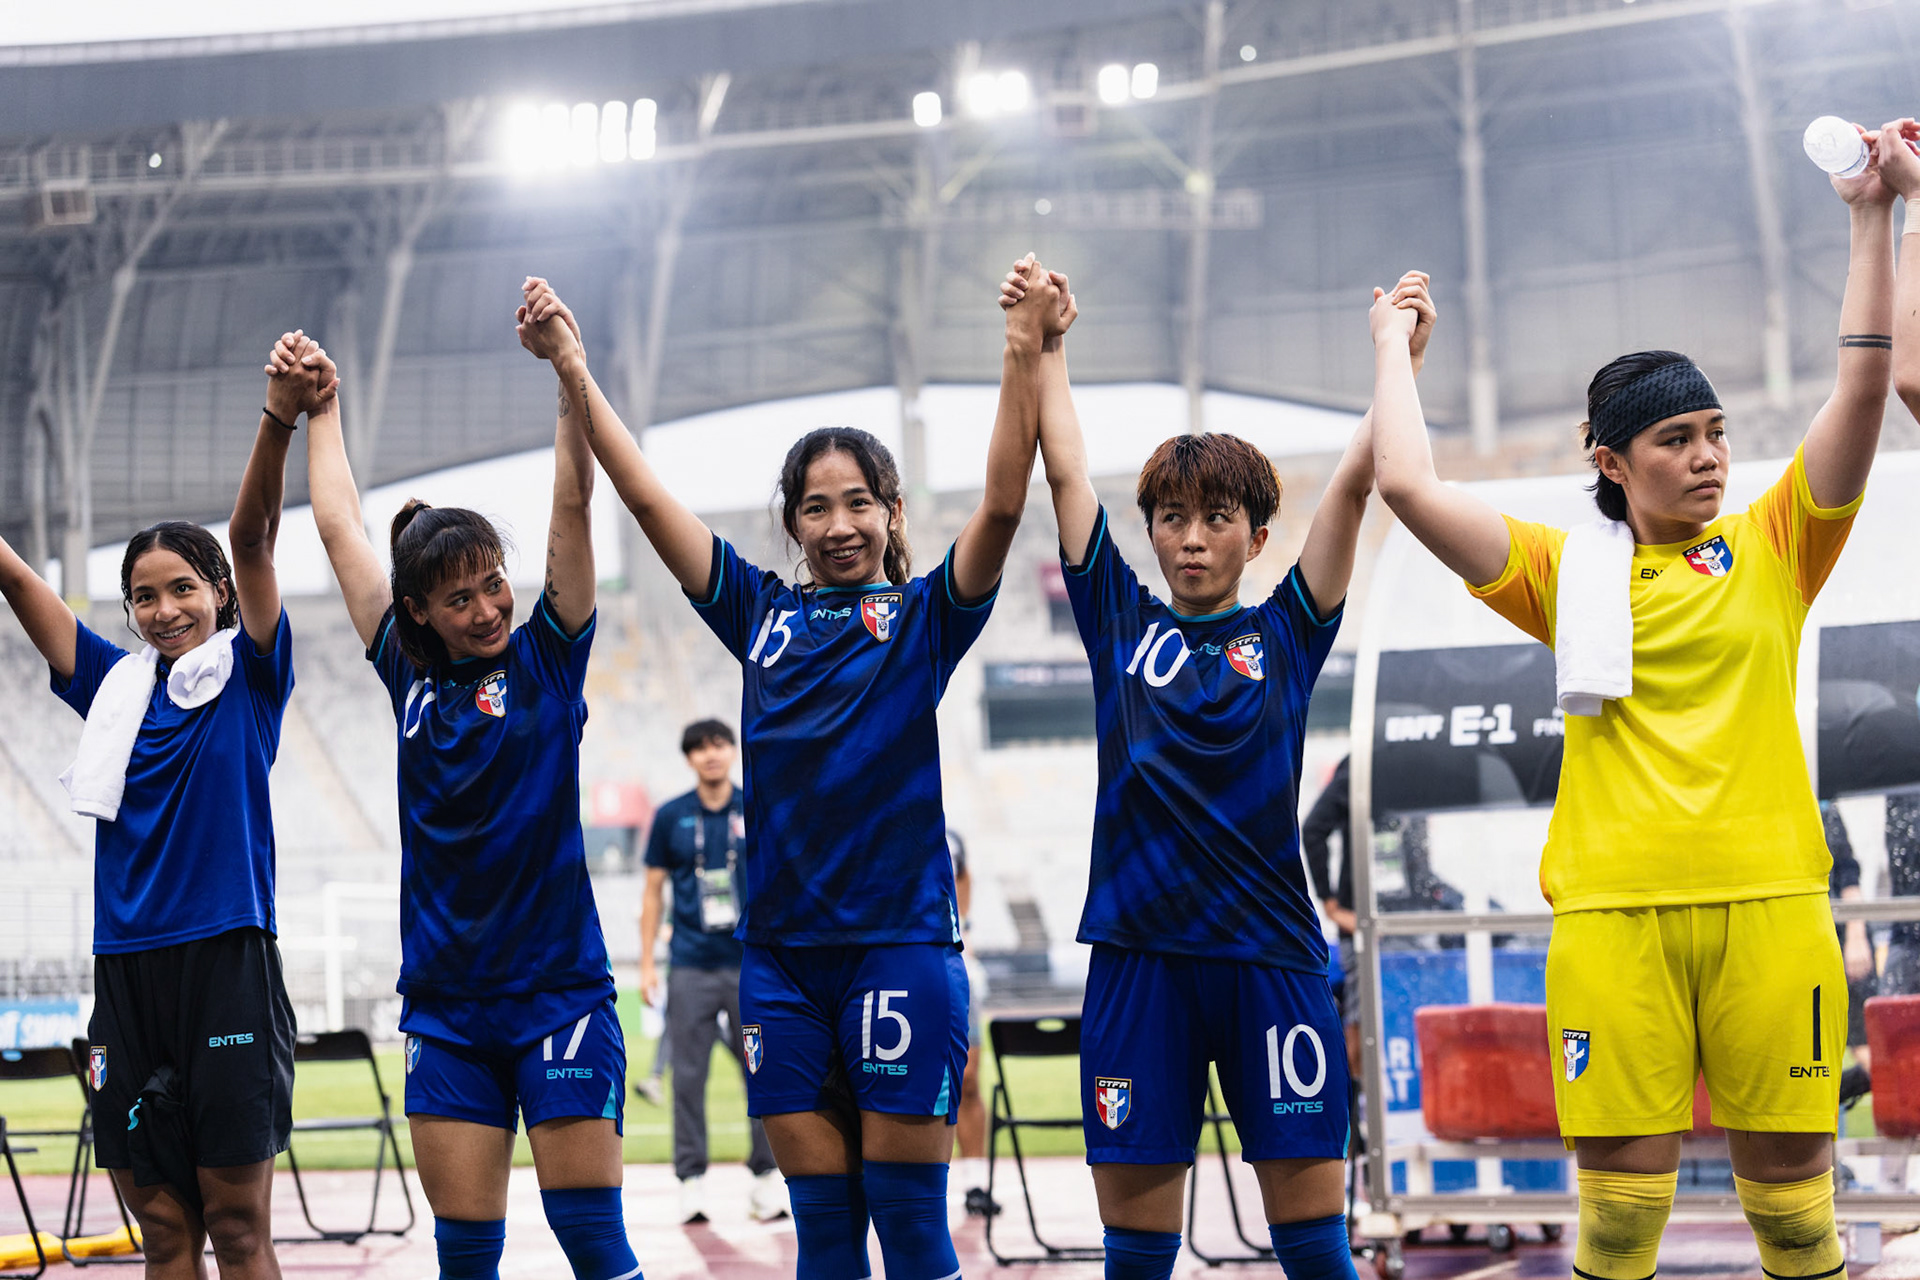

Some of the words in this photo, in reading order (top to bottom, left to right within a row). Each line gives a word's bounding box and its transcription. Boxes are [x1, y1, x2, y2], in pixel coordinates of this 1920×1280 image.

[1686, 536, 1720, 556] CTFA
[864, 595, 899, 604] CTFA
[748, 607, 798, 668] 15
[1228, 636, 1261, 650] CTFA
[1125, 621, 1190, 688] 10
[862, 990, 911, 1061] 15
[1812, 984, 1822, 1062] 1
[208, 1033, 254, 1048] ENTES
[1563, 1031, 1588, 1040] CTFA
[1266, 1023, 1327, 1099] 10
[546, 1068, 593, 1080] ENTES
[862, 1062, 908, 1076] ENTES
[1098, 1079, 1129, 1090] CTFA
[1272, 1101, 1324, 1114] ENTES
